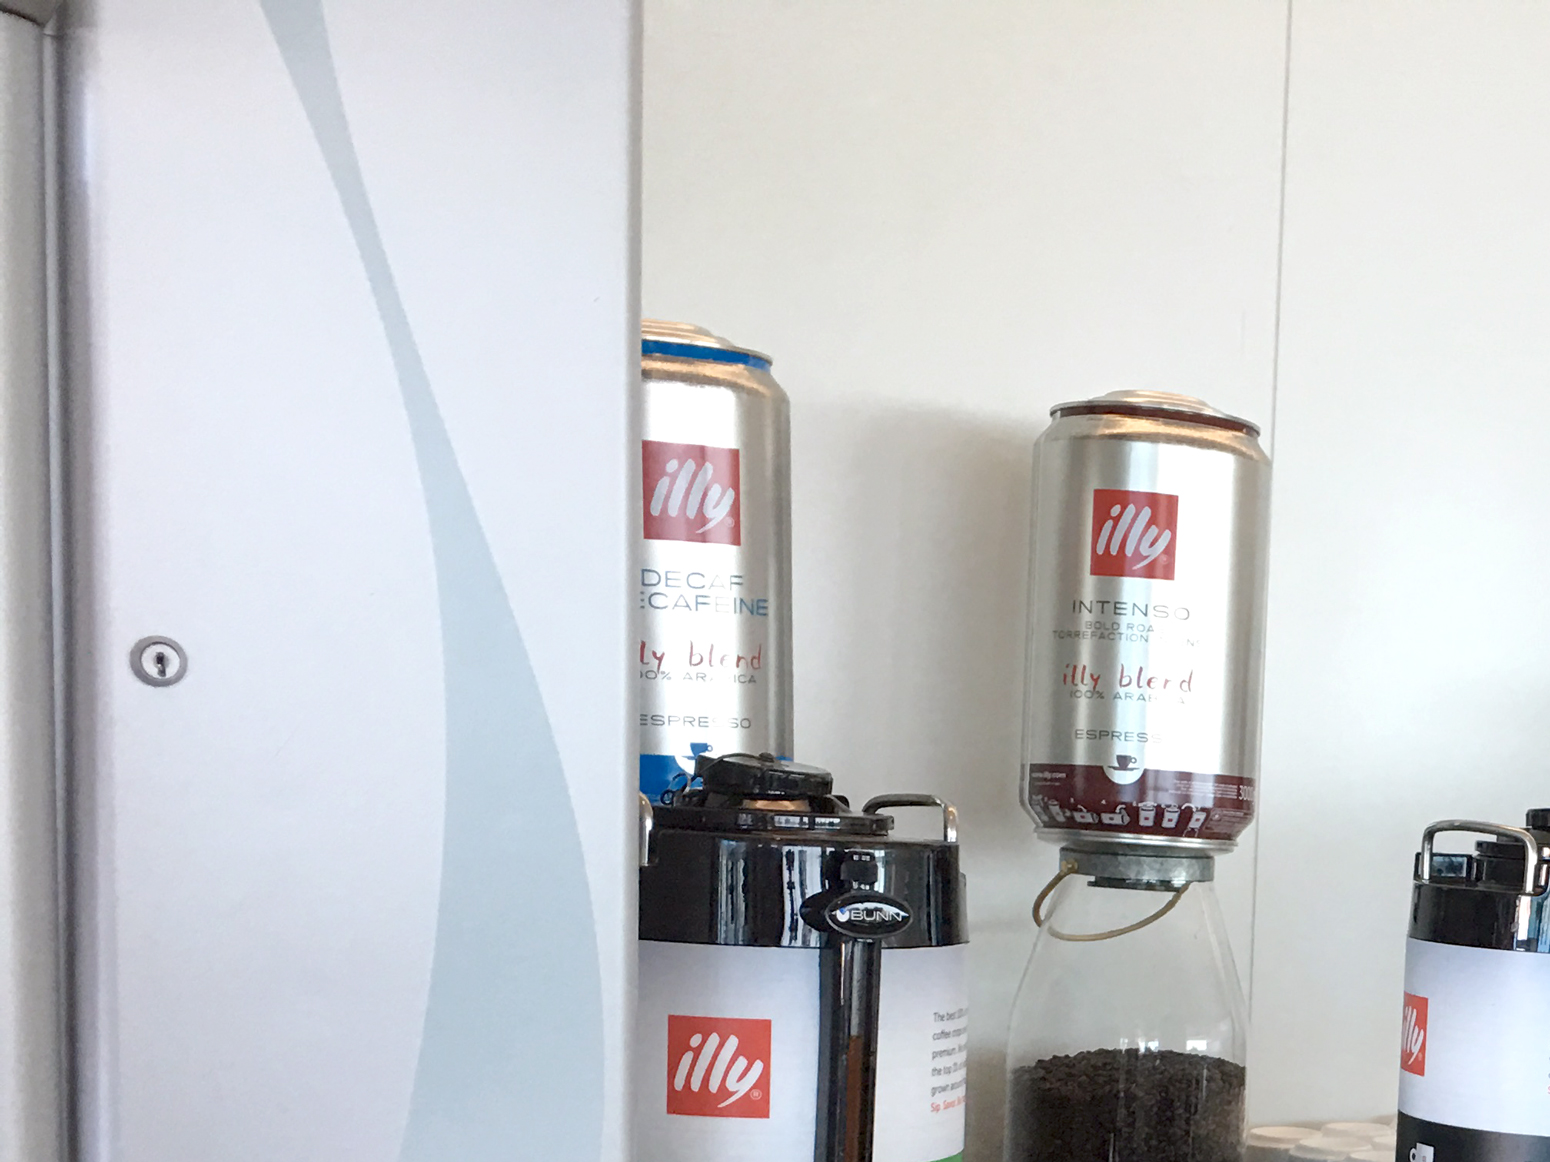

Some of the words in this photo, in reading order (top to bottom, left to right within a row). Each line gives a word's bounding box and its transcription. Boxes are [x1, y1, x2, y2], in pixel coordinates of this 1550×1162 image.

[650, 458, 734, 534] illy
[1097, 504, 1172, 571] illy
[641, 569, 743, 590] DECAF
[1072, 600, 1190, 621] INTENSO
[1053, 630, 1149, 643] TORREFACTION
[1085, 621, 1120, 632] BOLD
[689, 640, 762, 670] blend
[683, 672, 756, 684] ARICA
[1063, 663, 1101, 691] illy
[1070, 689, 1105, 700] 100%
[851, 909, 902, 921] BUNN
[674, 1032, 764, 1108] illy
